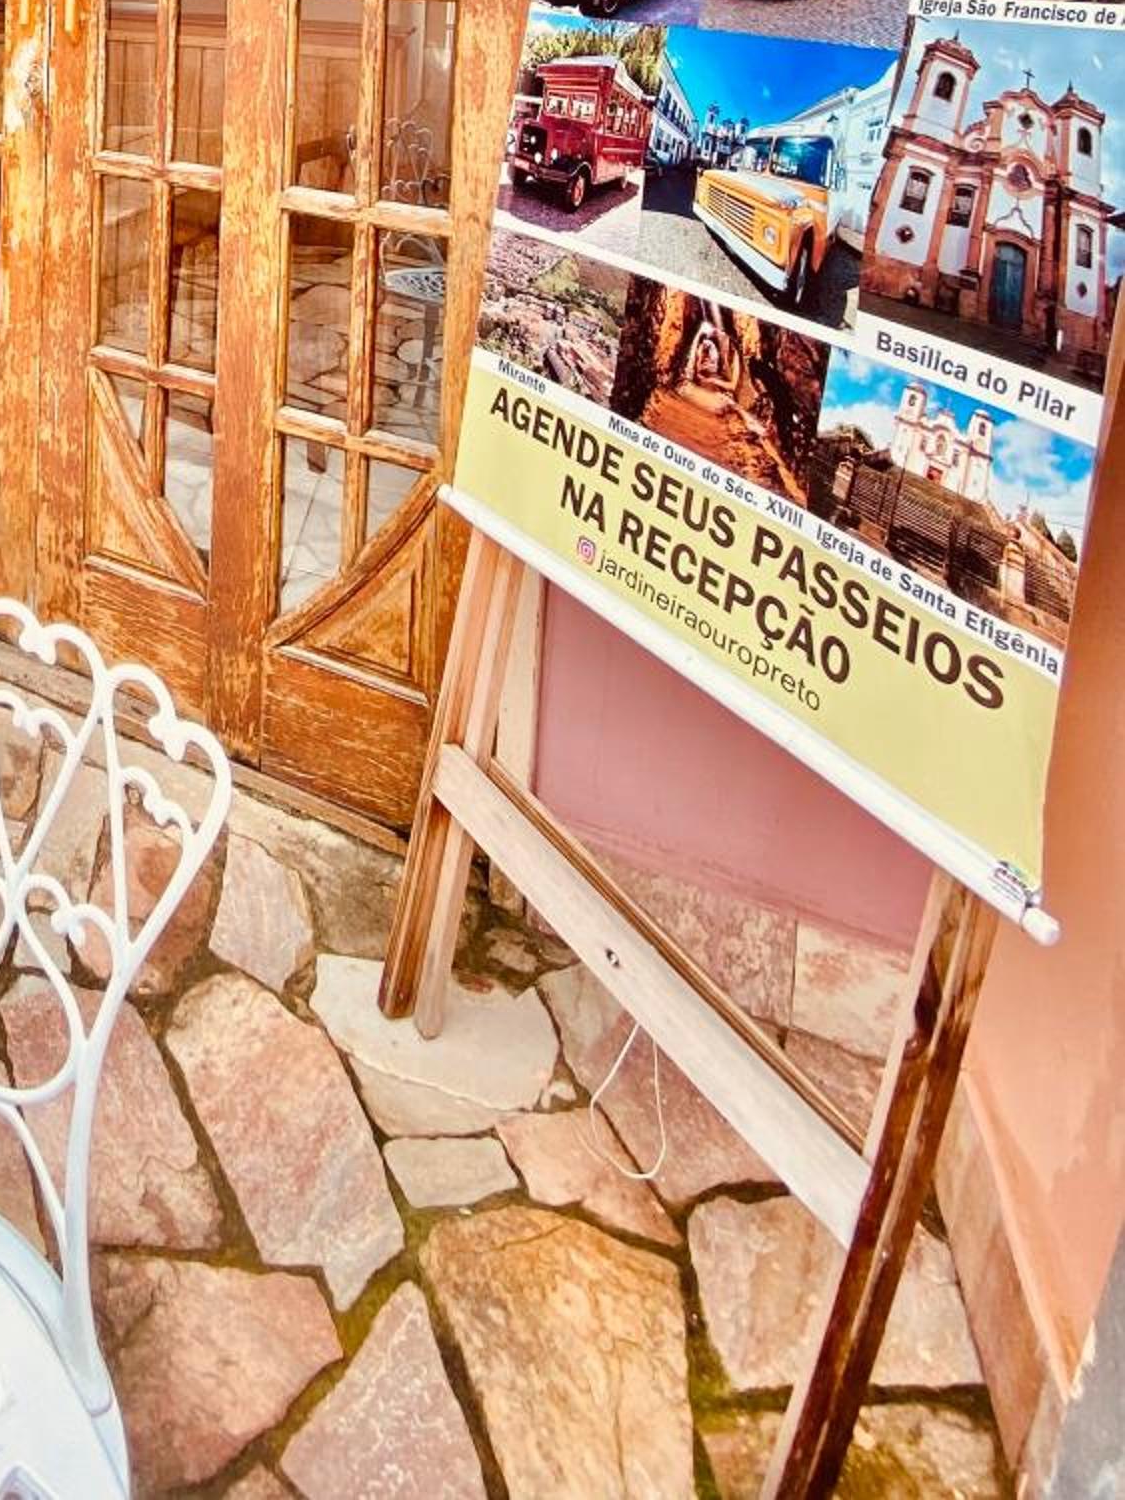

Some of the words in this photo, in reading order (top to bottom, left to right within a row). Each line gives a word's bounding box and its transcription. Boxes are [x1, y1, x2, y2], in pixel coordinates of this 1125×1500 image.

[966, 0, 996, 16] São
[1004, 2, 1087, 23] Francisco
[1094, 7, 1116, 25] de
[497, 359, 546, 394] Mirante
[876, 331, 968, 382] Basílica
[976, 367, 1008, 395] do
[1018, 380, 1078, 422] Pilar
[607, 415, 639, 443] Mina
[642, 431, 660, 453] de
[664, 445, 696, 472] Ouro
[701, 465, 720, 486] do
[725, 476, 758, 506] Séc.
[765, 495, 803, 529] XVIII
[490, 386, 624, 485] AGENDE
[630, 461, 737, 549] SEUS
[751, 523, 1005, 712] PASSEIOS
[560, 474, 607, 534] NA
[618, 508, 851, 685] RECEPÇÃO
[815, 520, 864, 566] Igreja
[870, 557, 893, 581] de
[898, 572, 957, 621] Santa
[964, 610, 1060, 676] Efigênia
[597, 550, 821, 711] jardineiraouropreto
